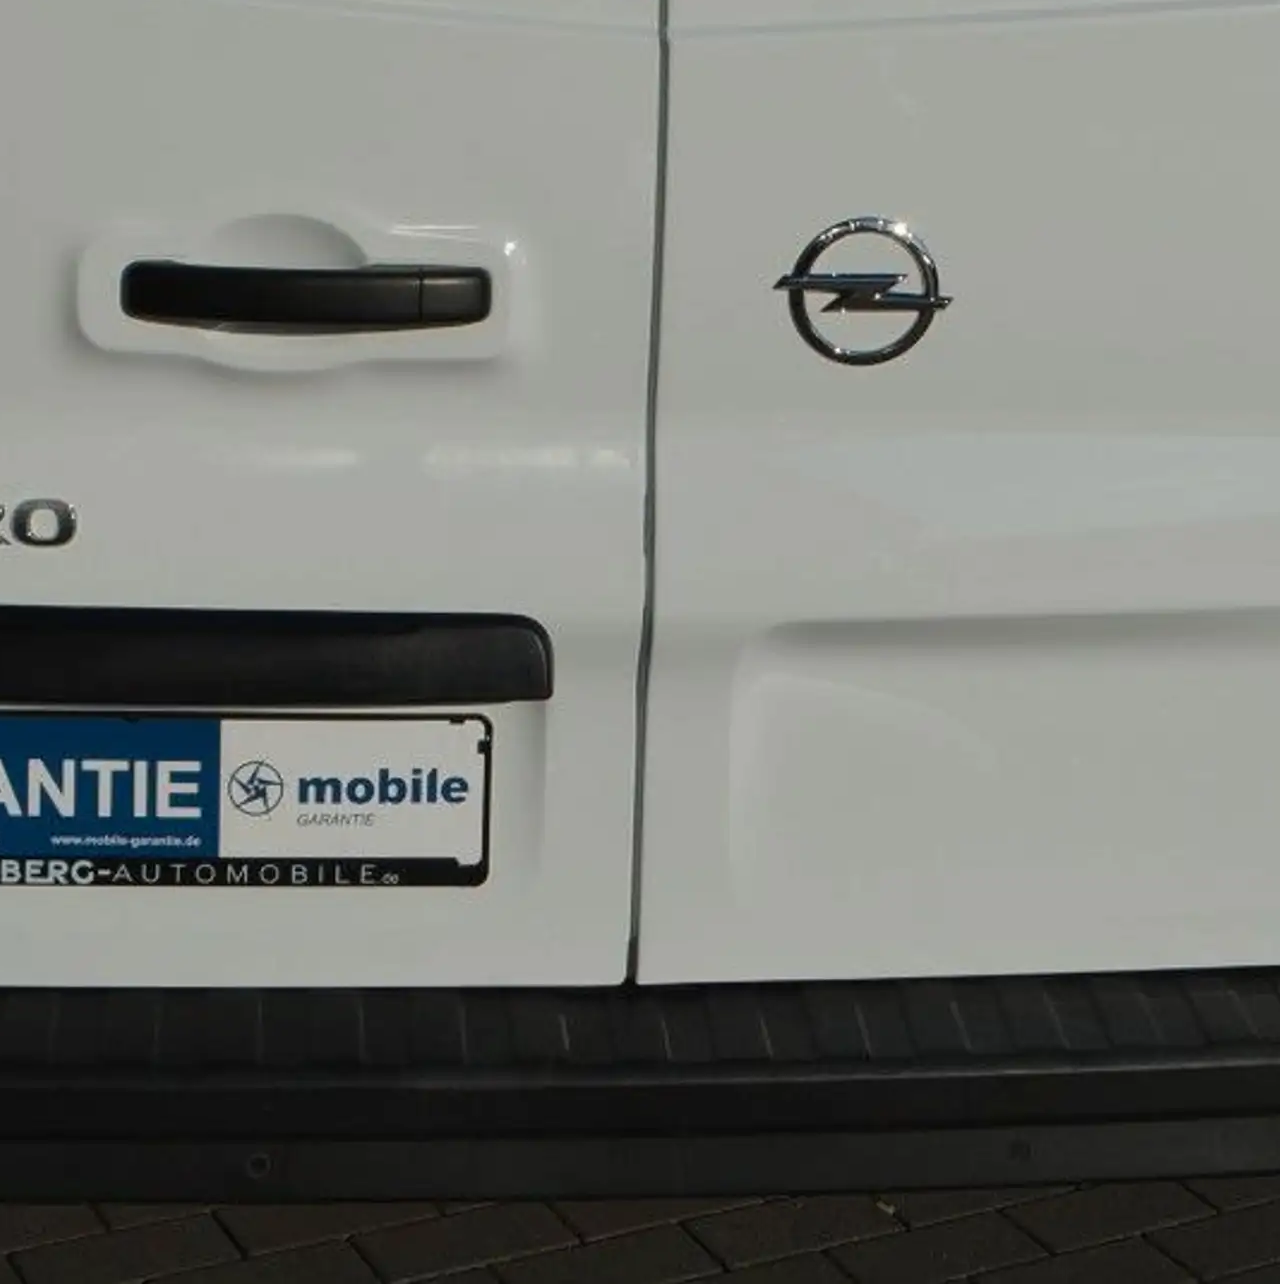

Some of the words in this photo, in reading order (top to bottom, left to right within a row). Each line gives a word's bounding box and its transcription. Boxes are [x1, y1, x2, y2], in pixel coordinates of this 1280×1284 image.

[297, 767, 470, 805] mobile
[296, 812, 376, 827] GARANTIE
[50, 834, 202, 848] www.mobile-garantie.de
